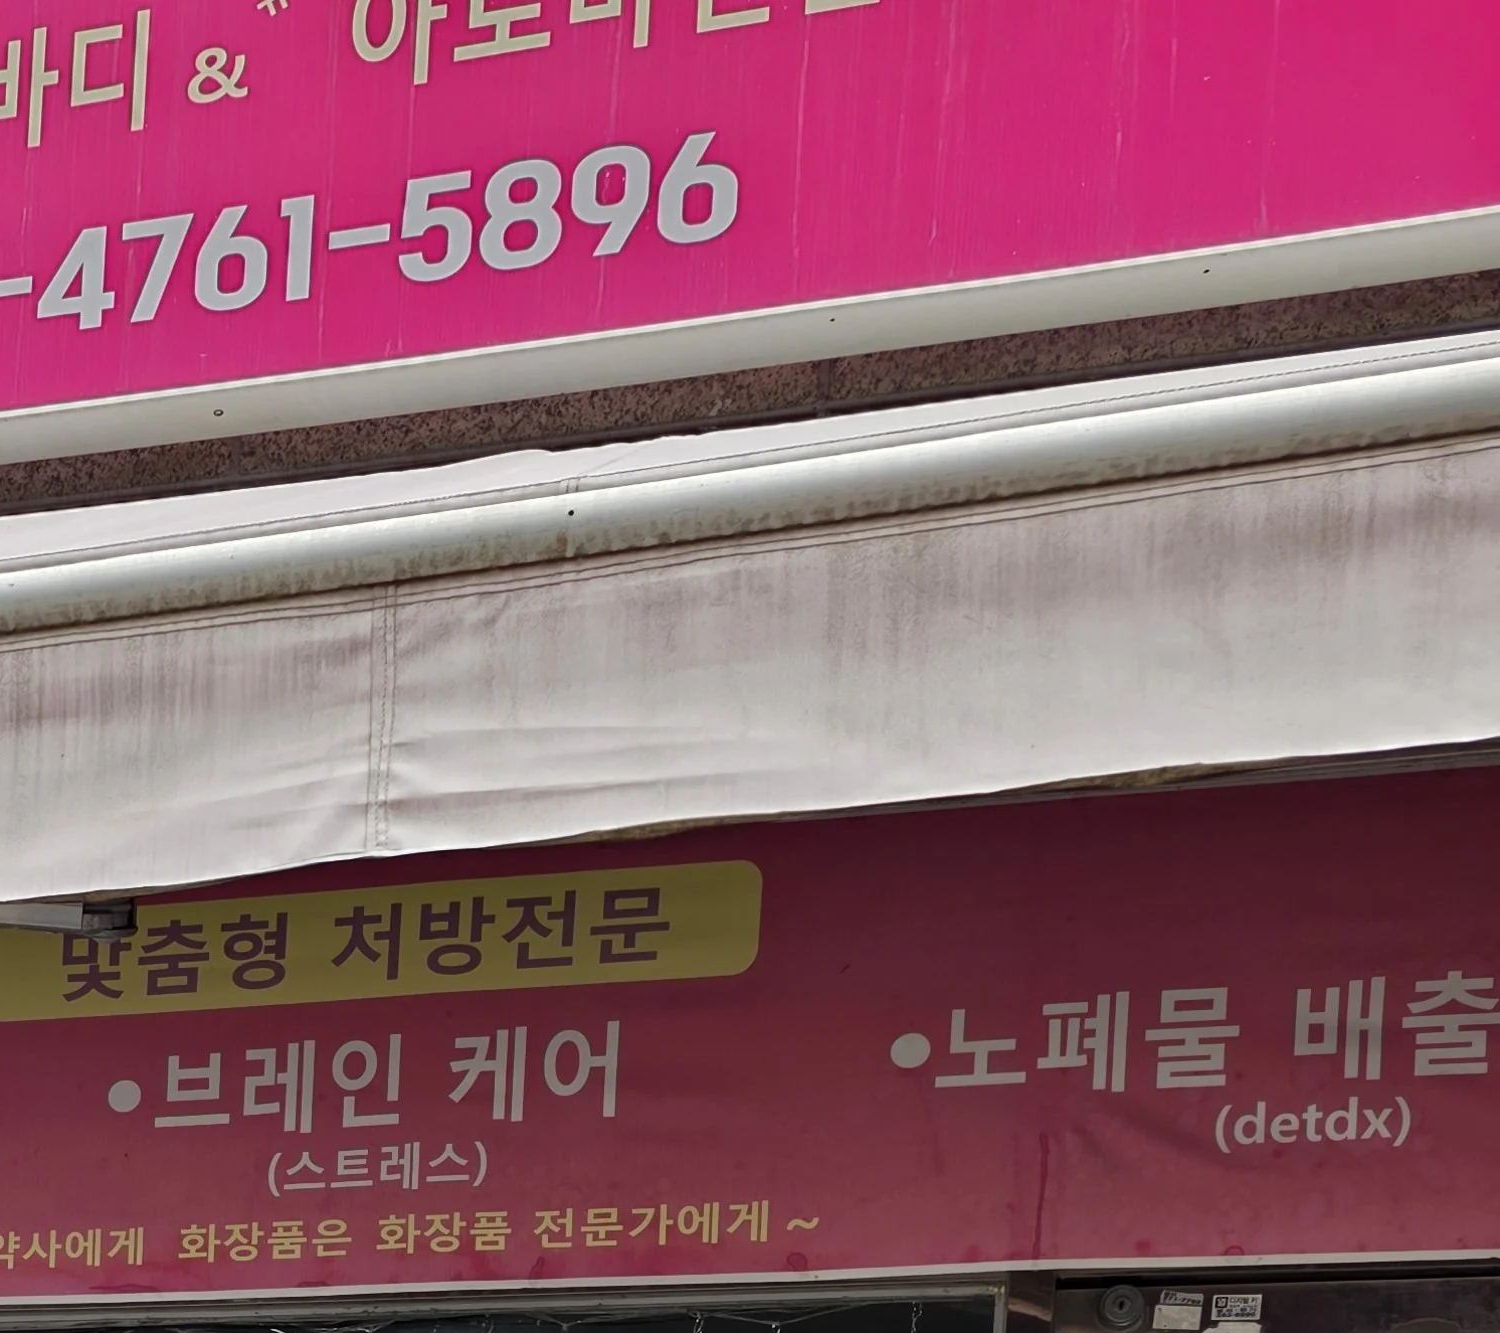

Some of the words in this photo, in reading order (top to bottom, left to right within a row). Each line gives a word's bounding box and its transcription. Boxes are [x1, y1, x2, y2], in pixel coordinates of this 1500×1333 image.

[187, 46, 249, 104] &
[61, 911, 289, 1003] 맞춤형
[330, 886, 673, 982] 처방전문
[934, 986, 1241, 1093] 노폐물
[1293, 969, 1500, 1080] 배출
[153, 1033, 400, 1134] 브레인
[449, 1020, 621, 1121] 케어
[1214, 1095, 1412, 1154] (detdx)
[267, 1137, 489, 1198] (스트레스)
[177, 1214, 353, 1265] 화장품은
[375, 1209, 513, 1258] 화장품
[534, 1199, 772, 1253] 전문가에게
